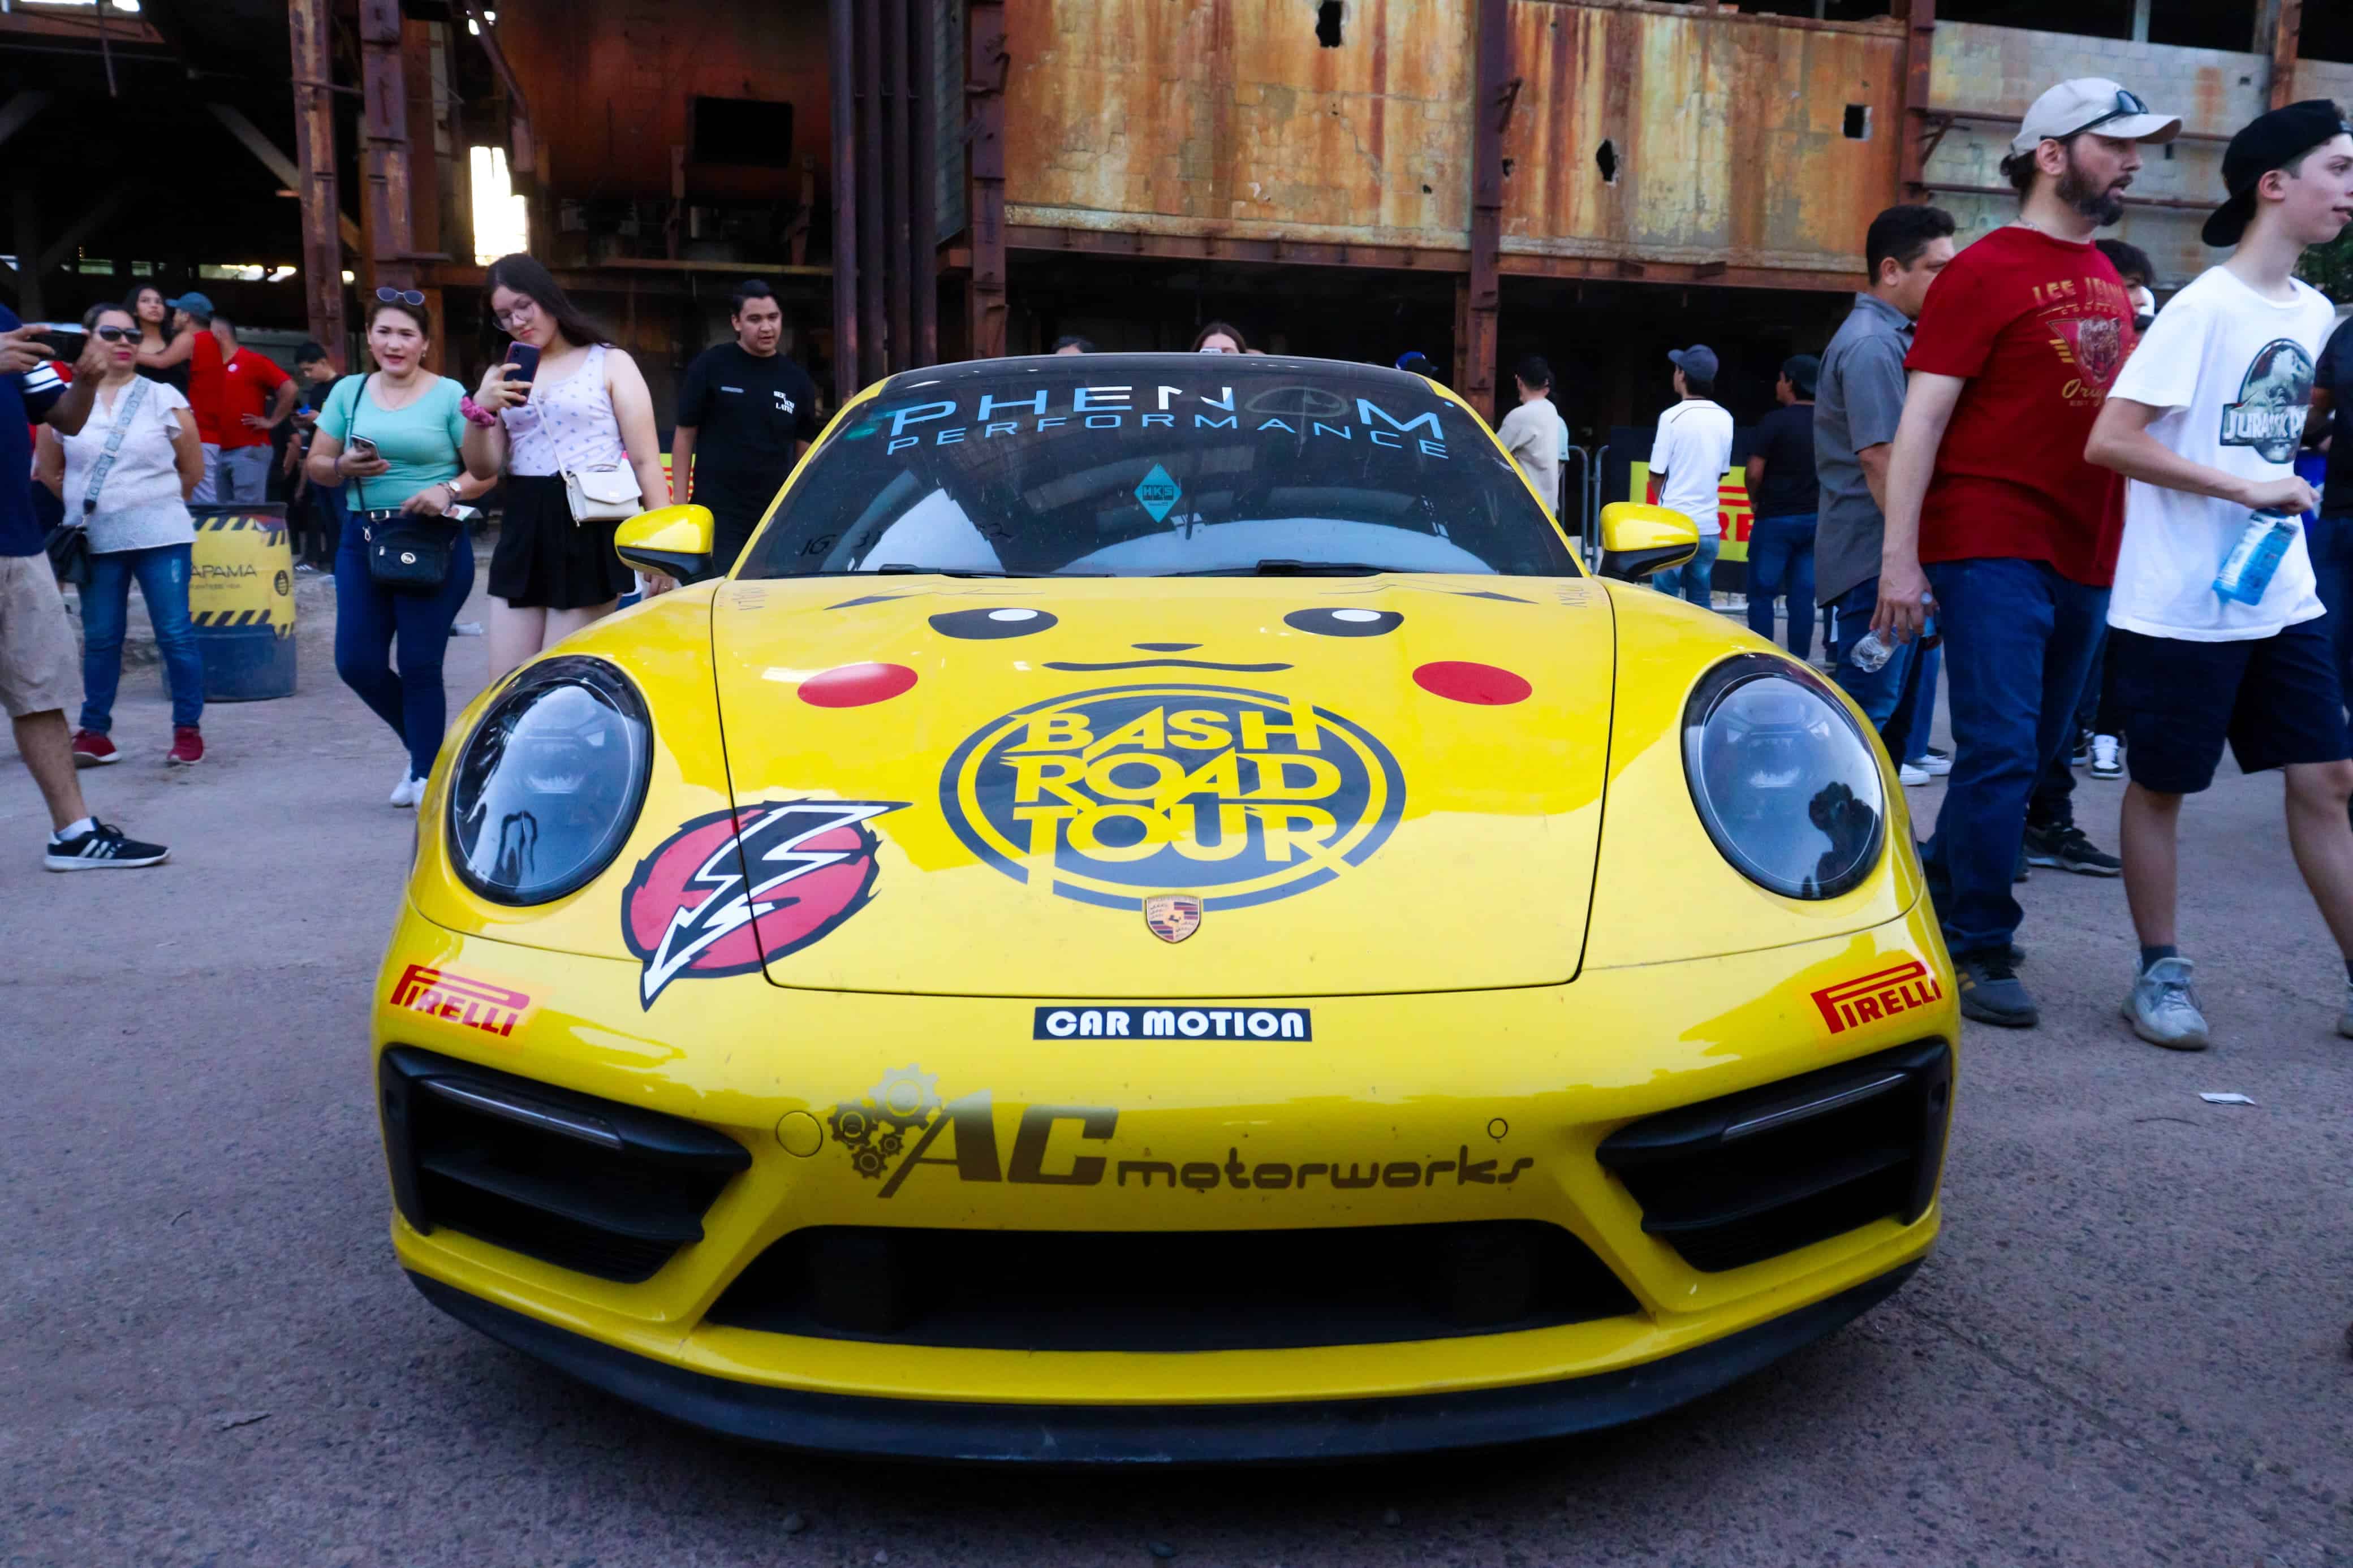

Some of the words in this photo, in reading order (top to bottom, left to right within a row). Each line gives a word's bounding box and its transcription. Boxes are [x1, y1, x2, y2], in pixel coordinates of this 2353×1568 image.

[886, 413, 1449, 460] PERFORMANCE
[1143, 485, 1173, 498] HKS
[1002, 704, 1322, 759] BASH
[1000, 748, 1342, 813] ROAD
[1012, 802, 1352, 879] TOUR
[390, 964, 530, 1037] PIRELLI
[1046, 1010, 1130, 1036] CAR
[1143, 1010, 1304, 1038] MOTION
[1810, 961, 1942, 1035] PIRELLI
[877, 1088, 1119, 1199] AC
[1117, 1144, 1534, 1189] motorworks
